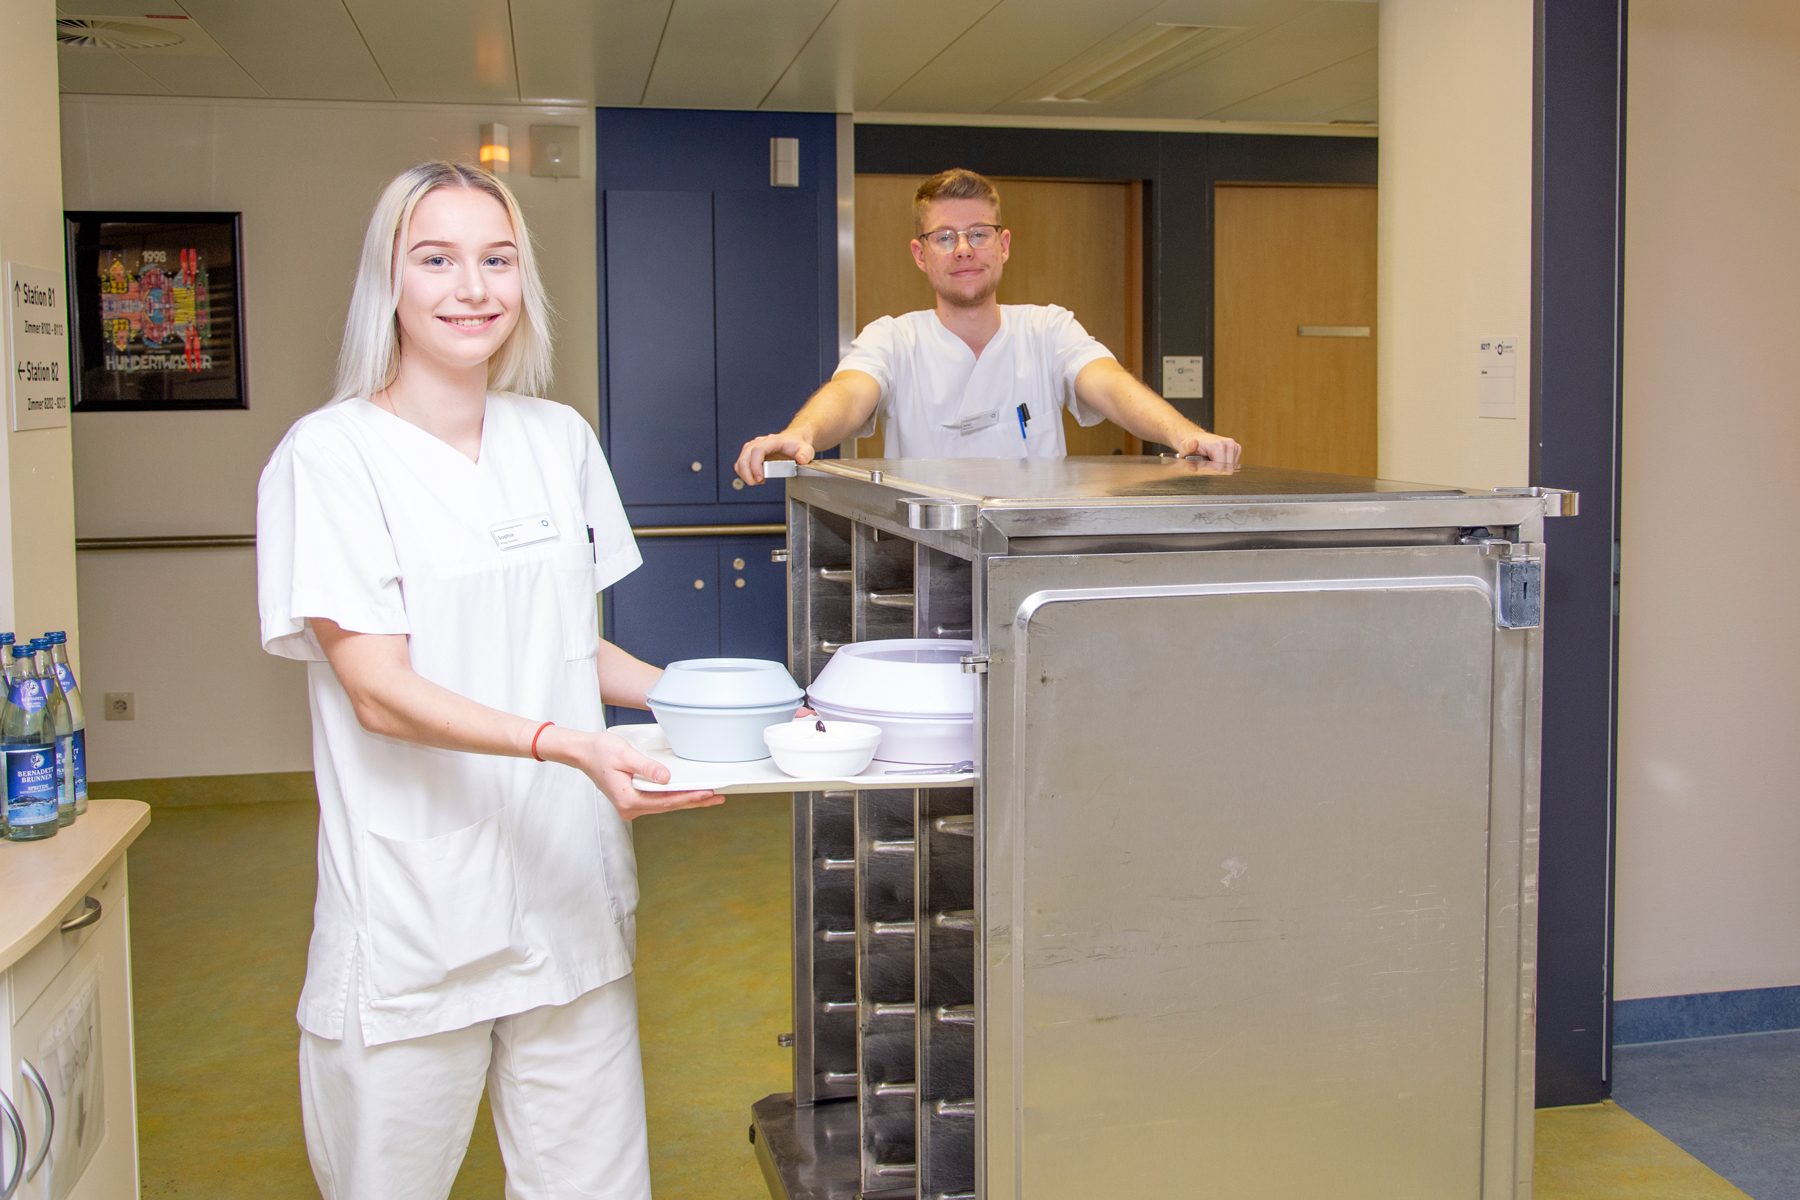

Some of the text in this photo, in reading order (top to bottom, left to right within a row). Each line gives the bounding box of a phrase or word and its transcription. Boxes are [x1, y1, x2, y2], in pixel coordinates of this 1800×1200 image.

[142, 250, 167, 262] 1998
[23, 283, 56, 308] Station 81
[24, 319, 41, 334] Zimmer
[27, 360, 59, 381] Station 82
[27, 397, 44, 410] Zimmer
[18, 766, 54, 777] BERNADETT
[22, 774, 52, 783] BRUNNEN
